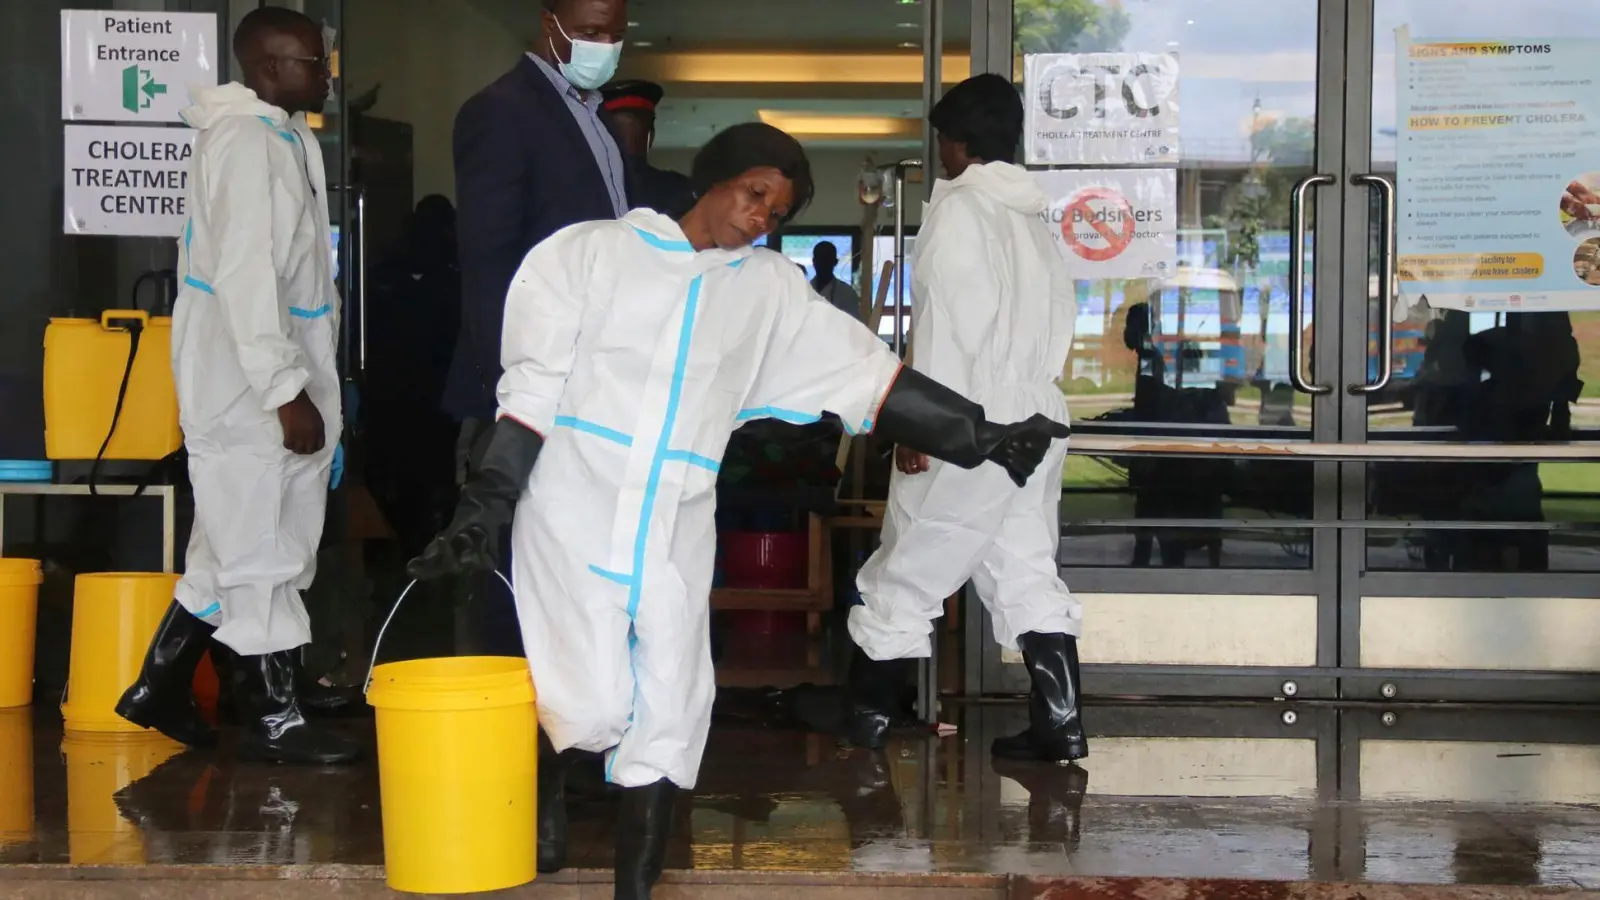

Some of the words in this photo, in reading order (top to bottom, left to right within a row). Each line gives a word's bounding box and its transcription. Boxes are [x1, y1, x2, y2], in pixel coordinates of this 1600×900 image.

[104, 17, 173, 34] Patient
[97, 45, 180, 62] Entrance
[1450, 46, 1477, 56] AND
[1481, 44, 1551, 56] SYMPTOMS
[1039, 64, 1161, 120] CTC
[1410, 116, 1440, 127] HOW
[1443, 115, 1460, 126] TO
[1464, 114, 1522, 126] PREVENT
[1525, 113, 1586, 124] CHOLERA
[1036, 130, 1076, 140] CHOLERA
[1077, 130, 1129, 139] TREATMENT
[1130, 129, 1162, 139] CENTRE
[88, 140, 193, 161] CHOLERA
[100, 195, 185, 215] CENTRE
[1038, 206, 1065, 223] NO
